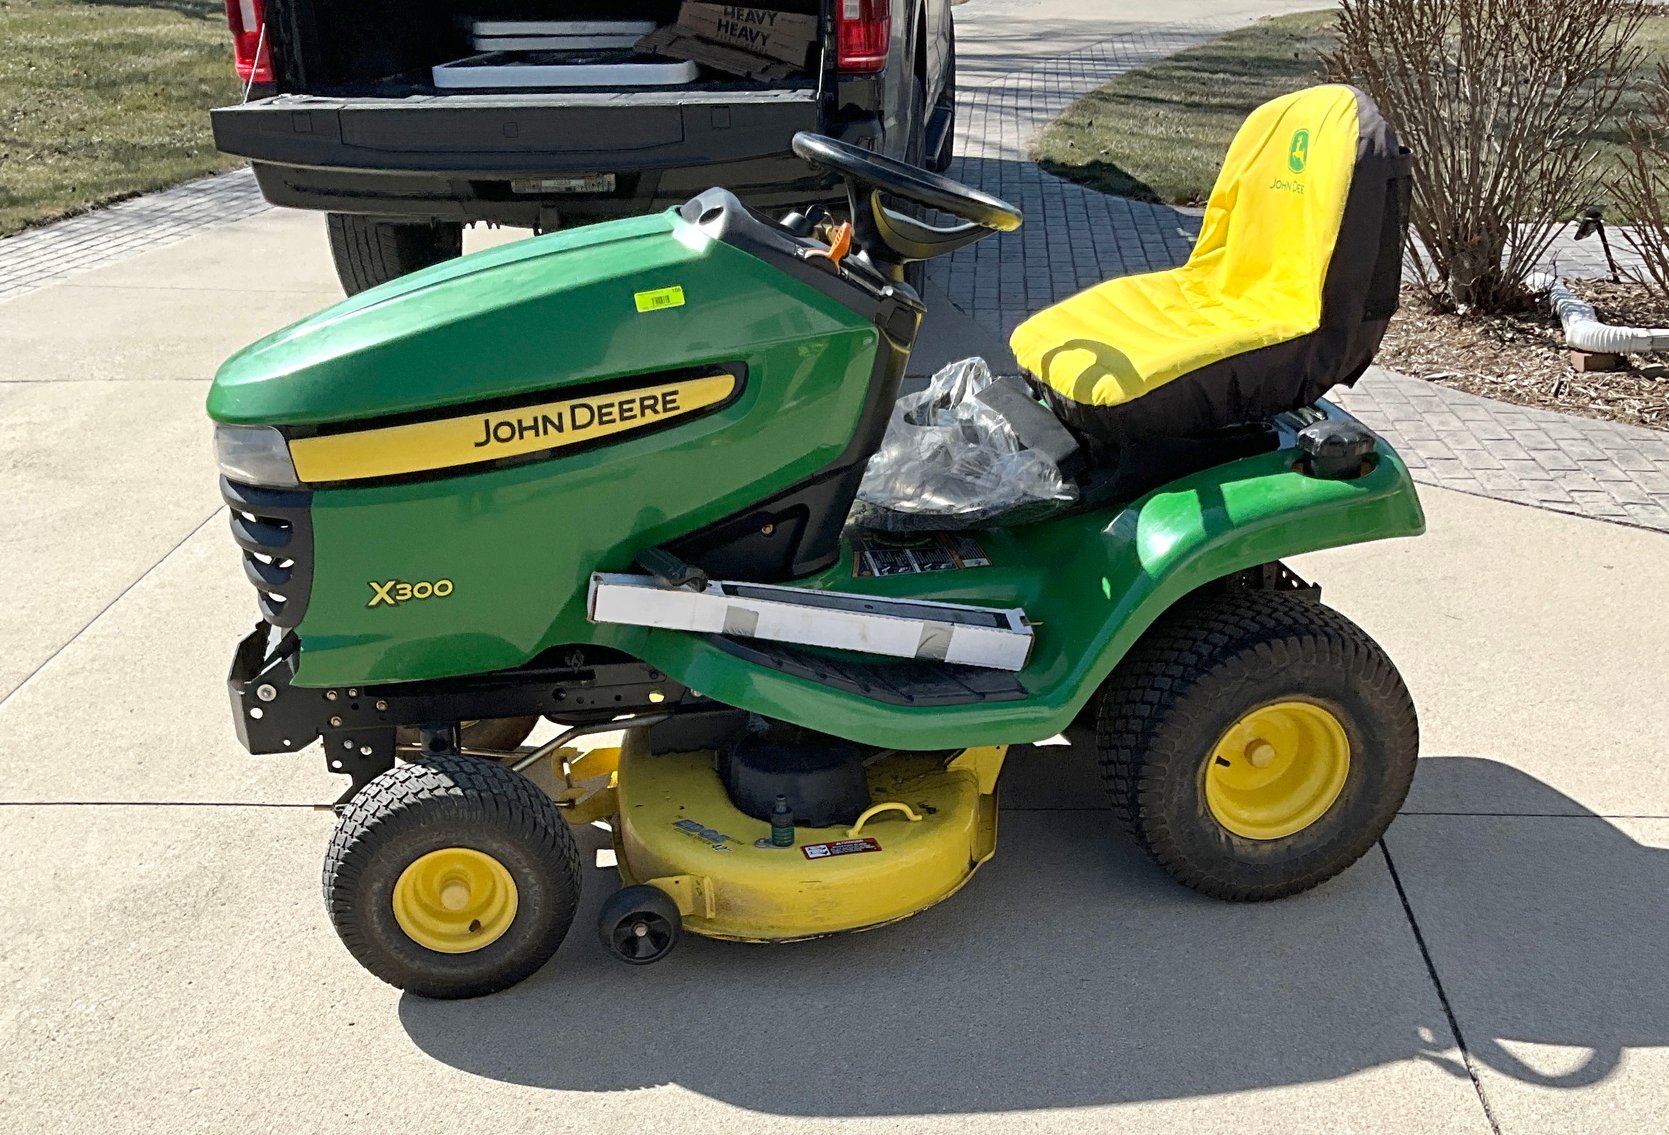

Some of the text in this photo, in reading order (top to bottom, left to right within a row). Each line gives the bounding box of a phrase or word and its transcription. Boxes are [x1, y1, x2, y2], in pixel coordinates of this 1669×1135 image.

[724, 5, 777, 26] HEAVY
[717, 18, 771, 46] HEAVY
[1270, 178, 1292, 191] JOHN
[474, 389, 681, 447] JOHN DEERE
[367, 577, 454, 607] X300
